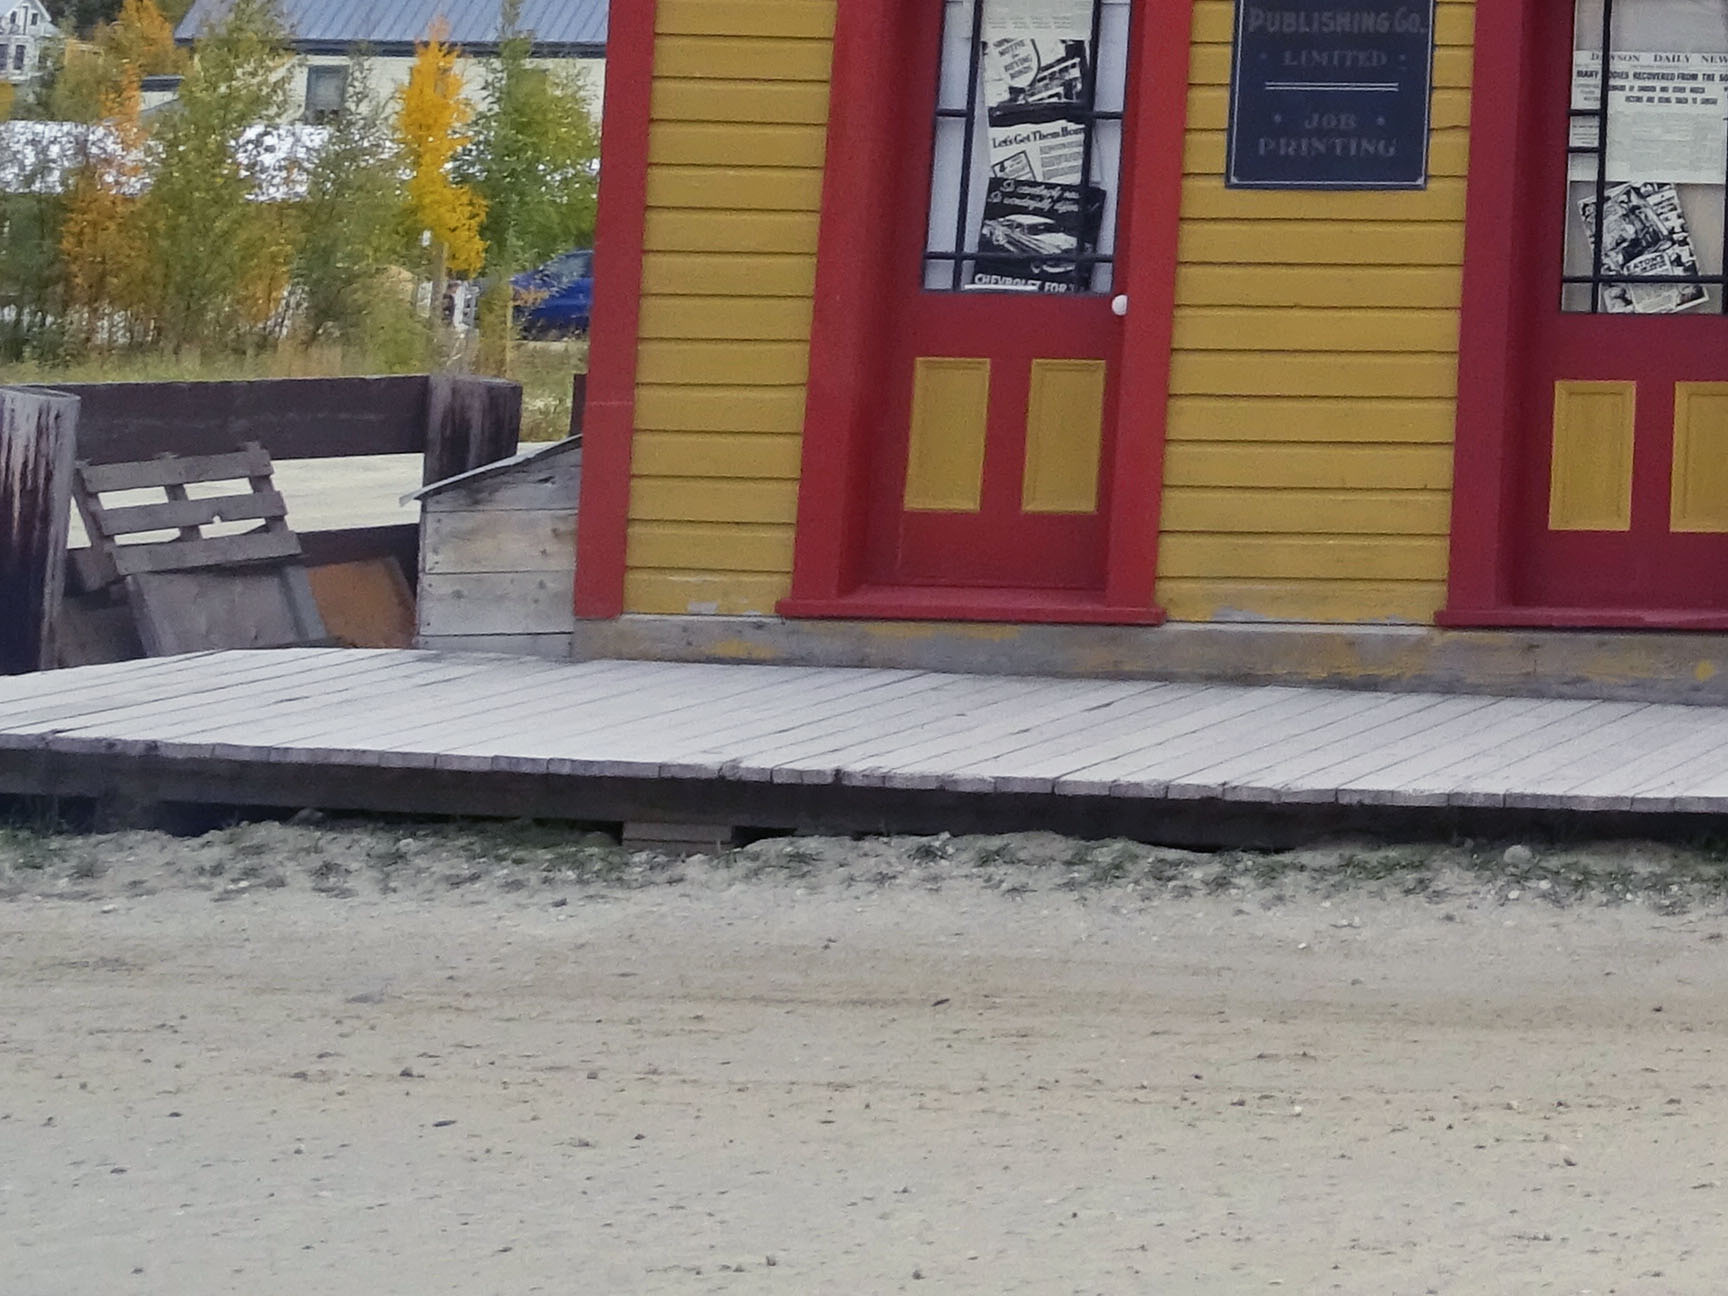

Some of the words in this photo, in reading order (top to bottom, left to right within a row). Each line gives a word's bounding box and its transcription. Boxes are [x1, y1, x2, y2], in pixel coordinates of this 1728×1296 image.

[1280, 49, 1388, 68] LIMITED
[1653, 53, 1691, 63] DAILY
[1677, 72, 1699, 82] FROM
[1702, 72, 1716, 83] THE
[1303, 112, 1358, 130] JOB
[1258, 137, 1398, 158] PRINTING
